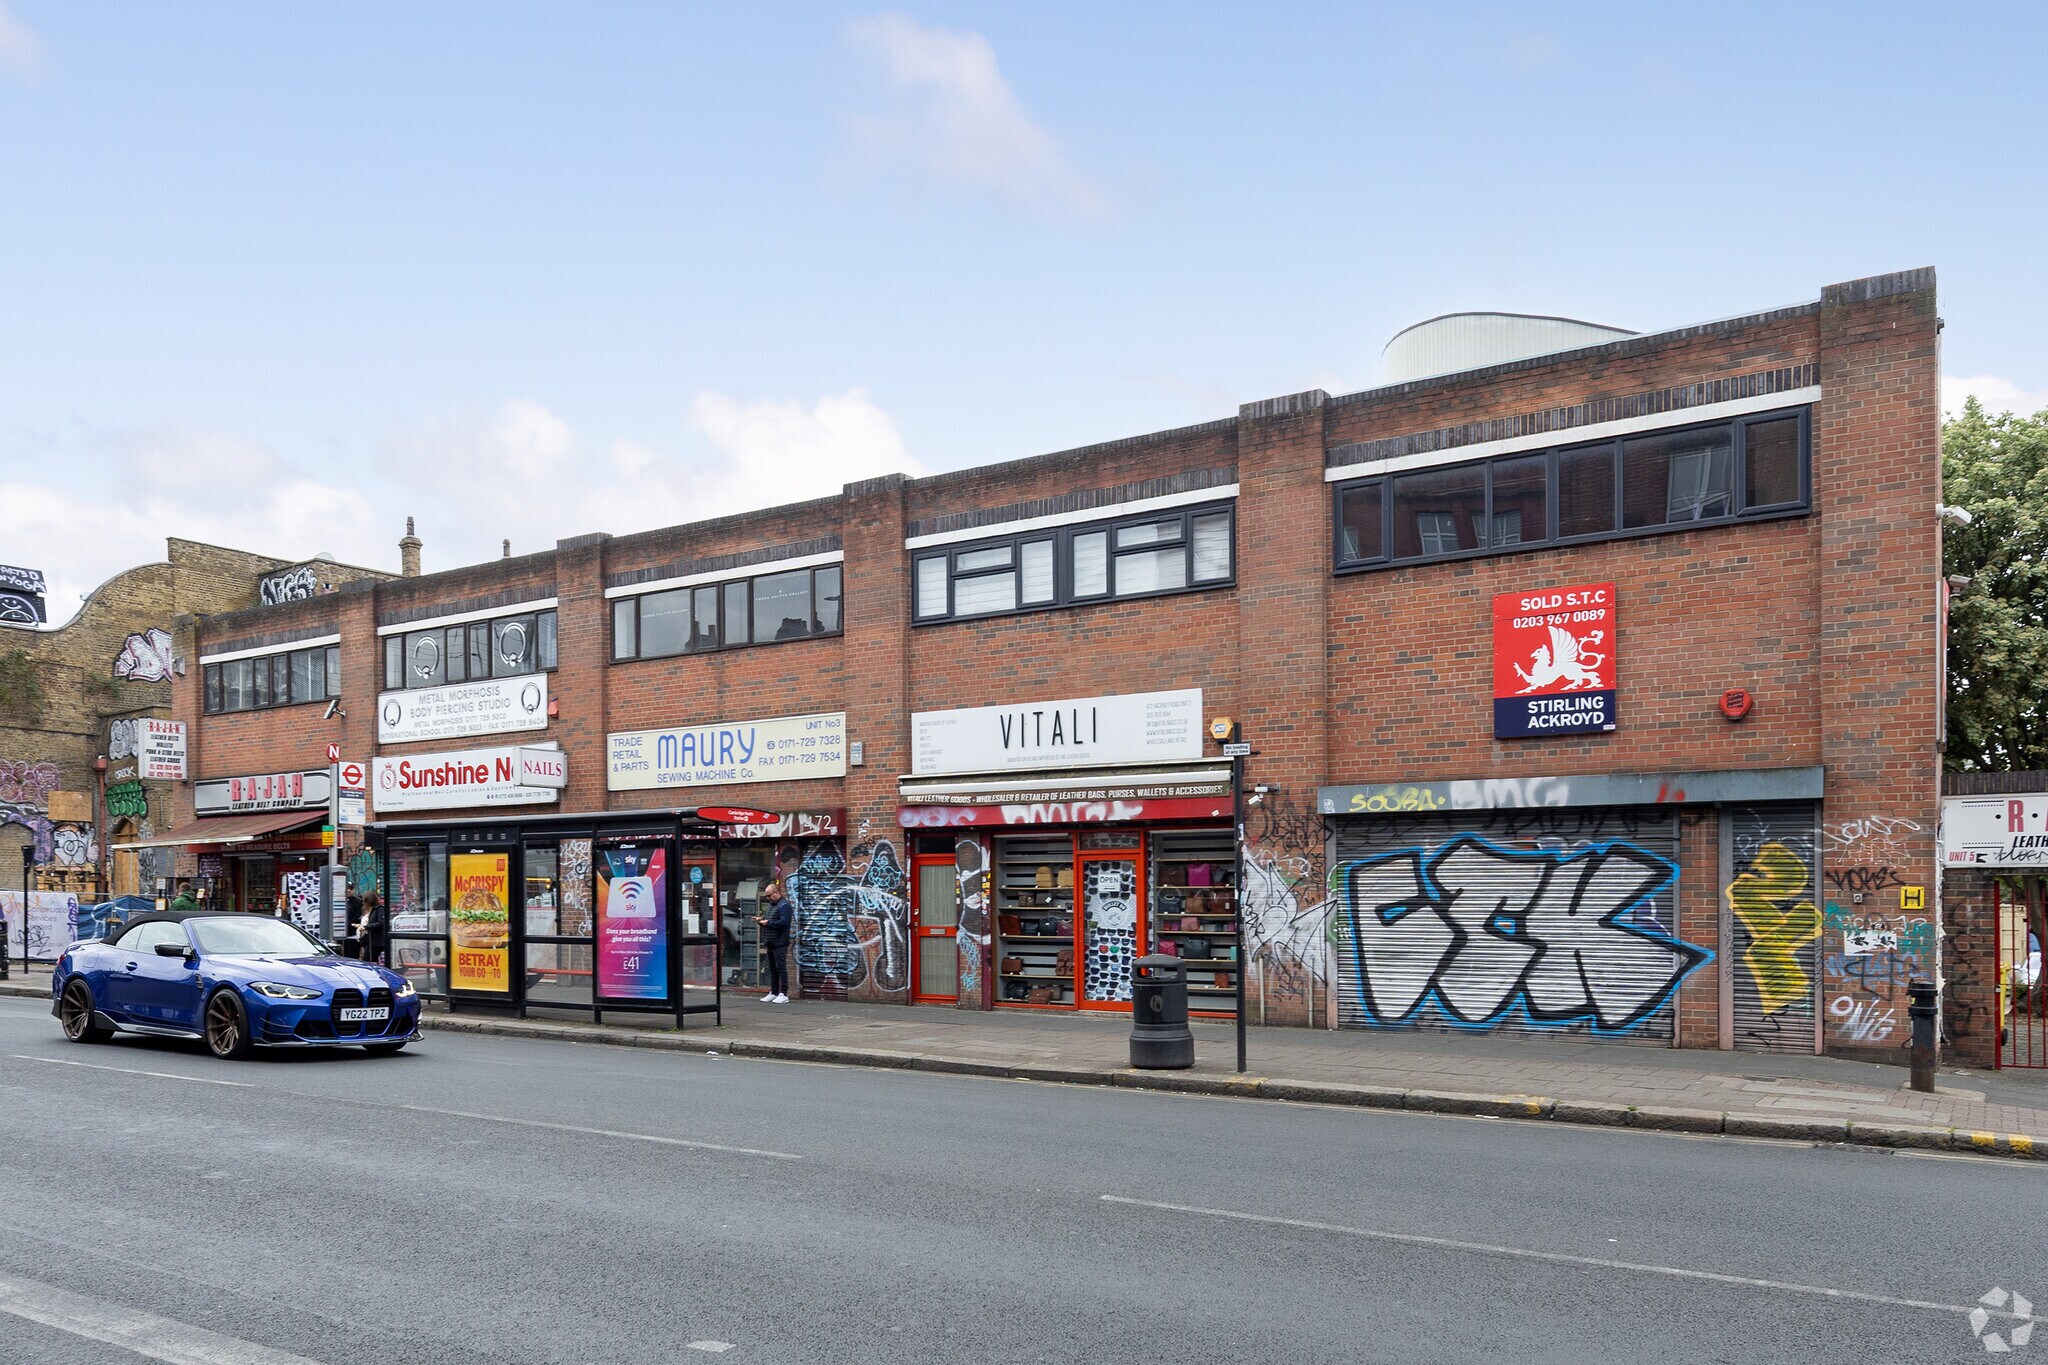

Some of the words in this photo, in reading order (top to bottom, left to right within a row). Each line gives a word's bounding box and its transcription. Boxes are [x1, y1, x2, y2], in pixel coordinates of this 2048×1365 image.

[1520, 595, 1562, 611] SOLD
[1566, 590, 1606, 606] S.T.C
[1513, 617, 1544, 629] 0203
[1547, 612, 1570, 626] 967
[1573, 609, 1606, 622] 0089
[419, 692, 444, 705] METAL
[450, 686, 501, 700] MORPHOSIS
[410, 706, 432, 718] BODY
[436, 702, 474, 716] PIERCING
[478, 698, 511, 711] STUDIO
[1527, 696, 1604, 714] STIRLING
[805, 720, 822, 730] UNIT
[1000, 706, 1096, 749] VITALI
[1527, 711, 1605, 729] ACKROYD
[613, 737, 643, 748] TRADE
[658, 728, 756, 769] MAURY
[778, 737, 816, 749] 0171-729
[819, 735, 841, 746] 7328
[329, 745, 340, 759] N
[613, 749, 642, 760] RETAIL
[758, 756, 775, 767] FAX
[779, 753, 816, 766] 0171-729
[819, 752, 841, 763] 7534
[524, 760, 562, 777] NAILS
[613, 763, 619, 772] &
[620, 761, 649, 772] PARTS
[399, 760, 489, 790] Sunshine
[657, 772, 692, 784] SEWING
[695, 769, 736, 781] MACHINE
[925, 795, 950, 803] LEATHER
[976, 794, 1014, 803] WHOLESALER
[1021, 792, 1049, 801] RETAILER
[1050, 792, 1059, 800] OF
[1059, 790, 1087, 800] LEATHER
[1137, 787, 1167, 796] WALLETS
[1168, 787, 1174, 795] &
[1175, 785, 1223, 796] ACCESSORIES
[232, 802, 255, 810] LEATHER
[272, 799, 301, 807] COMPANY
[624, 855, 637, 865] sky
[1949, 852, 1968, 861] UNIT
[1969, 852, 1975, 862] 5
[454, 875, 505, 892] McCRISPY
[1904, 889, 1920, 907] H
[625, 903, 637, 912] sky
[458, 952, 501, 968] BETRAY
[459, 967, 476, 978] YOUR
[345, 1009, 368, 1019] YG22
[370, 1008, 386, 1018] TPZ
